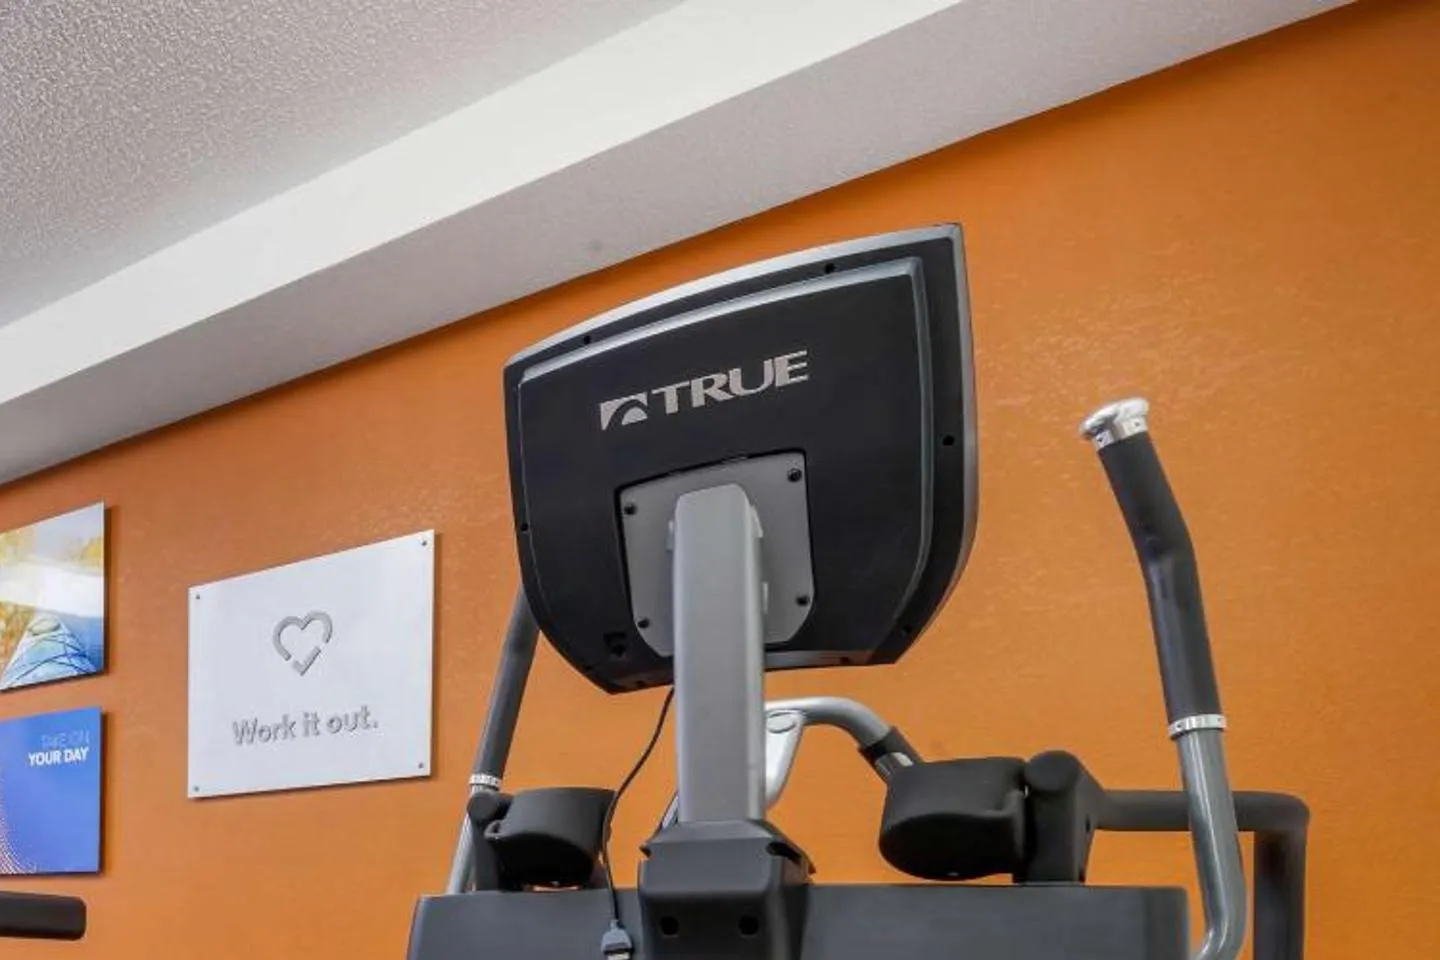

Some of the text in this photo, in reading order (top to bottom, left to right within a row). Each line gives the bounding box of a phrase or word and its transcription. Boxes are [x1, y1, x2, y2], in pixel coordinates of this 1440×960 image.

[652, 350, 808, 414] TRUE
[232, 705, 379, 745] Work it out.
[28, 746, 89, 766] YOUR DAY
